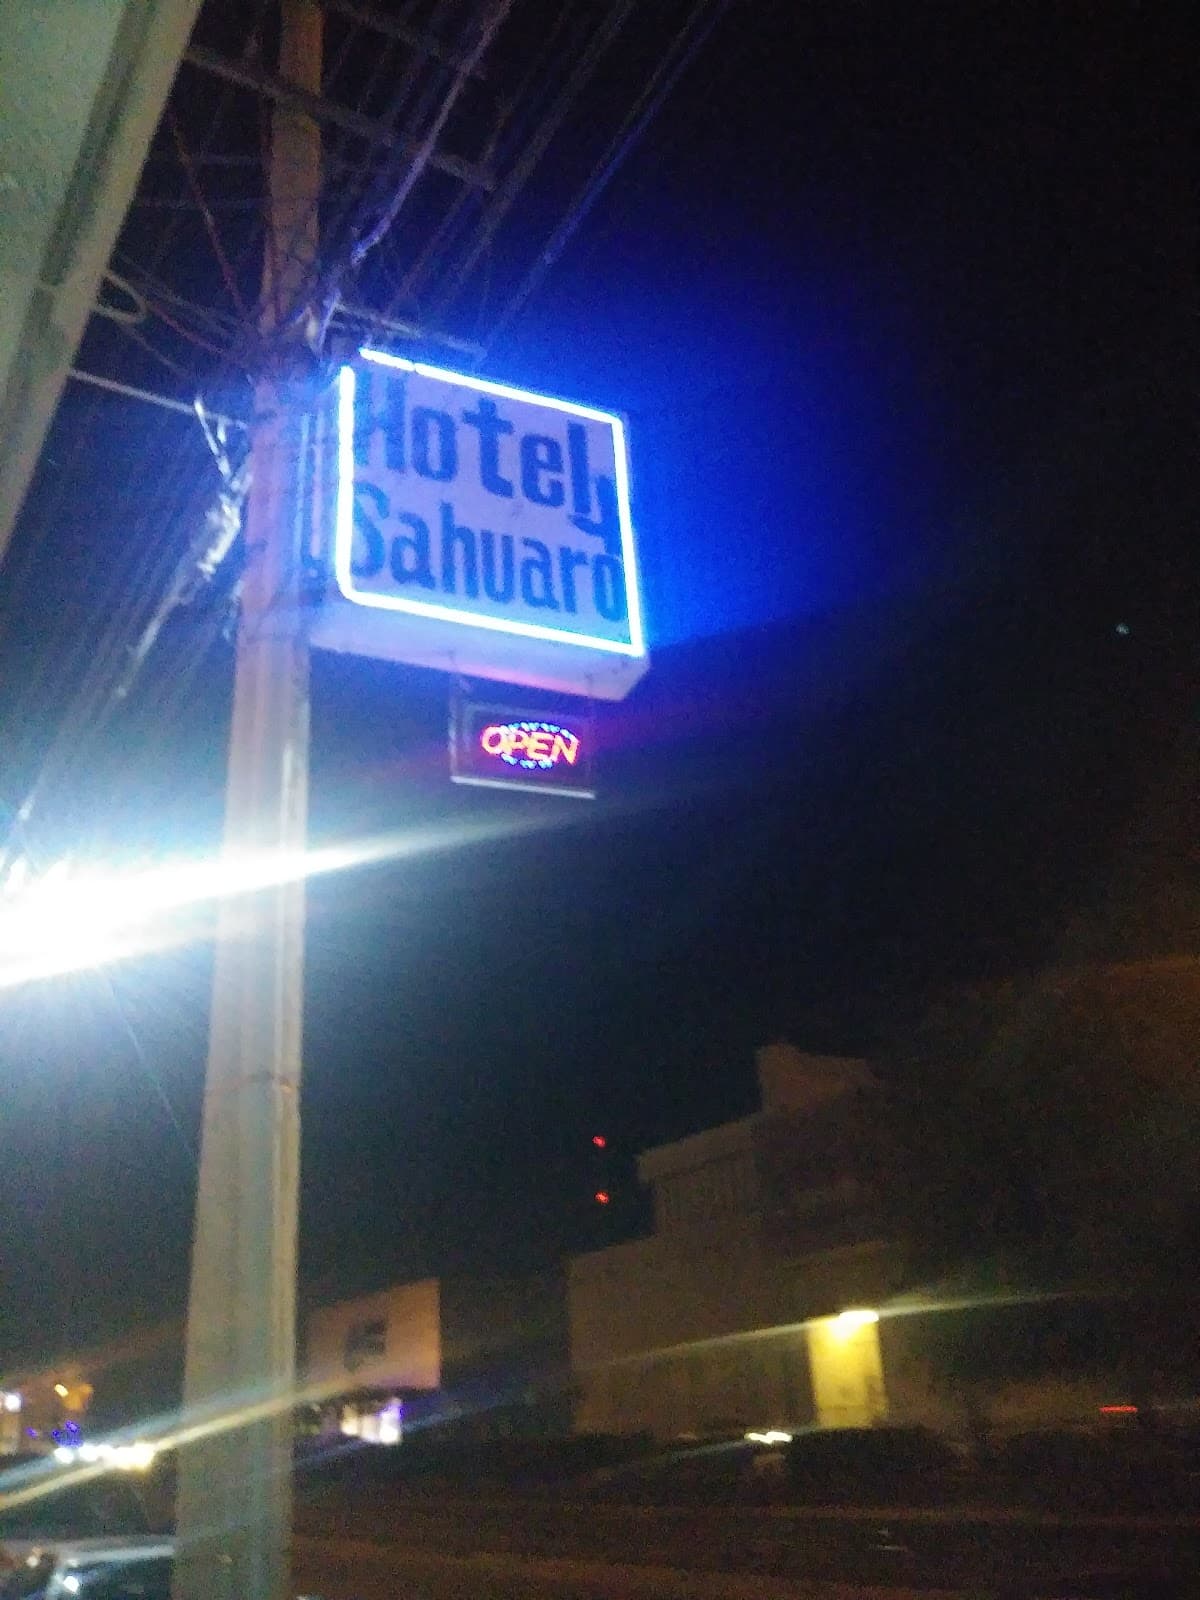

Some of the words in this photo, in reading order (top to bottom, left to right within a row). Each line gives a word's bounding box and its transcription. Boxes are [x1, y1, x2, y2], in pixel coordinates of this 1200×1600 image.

[354, 369, 592, 516] Hotel
[351, 482, 627, 622] Sahuaro
[481, 725, 580, 766] OPEN
